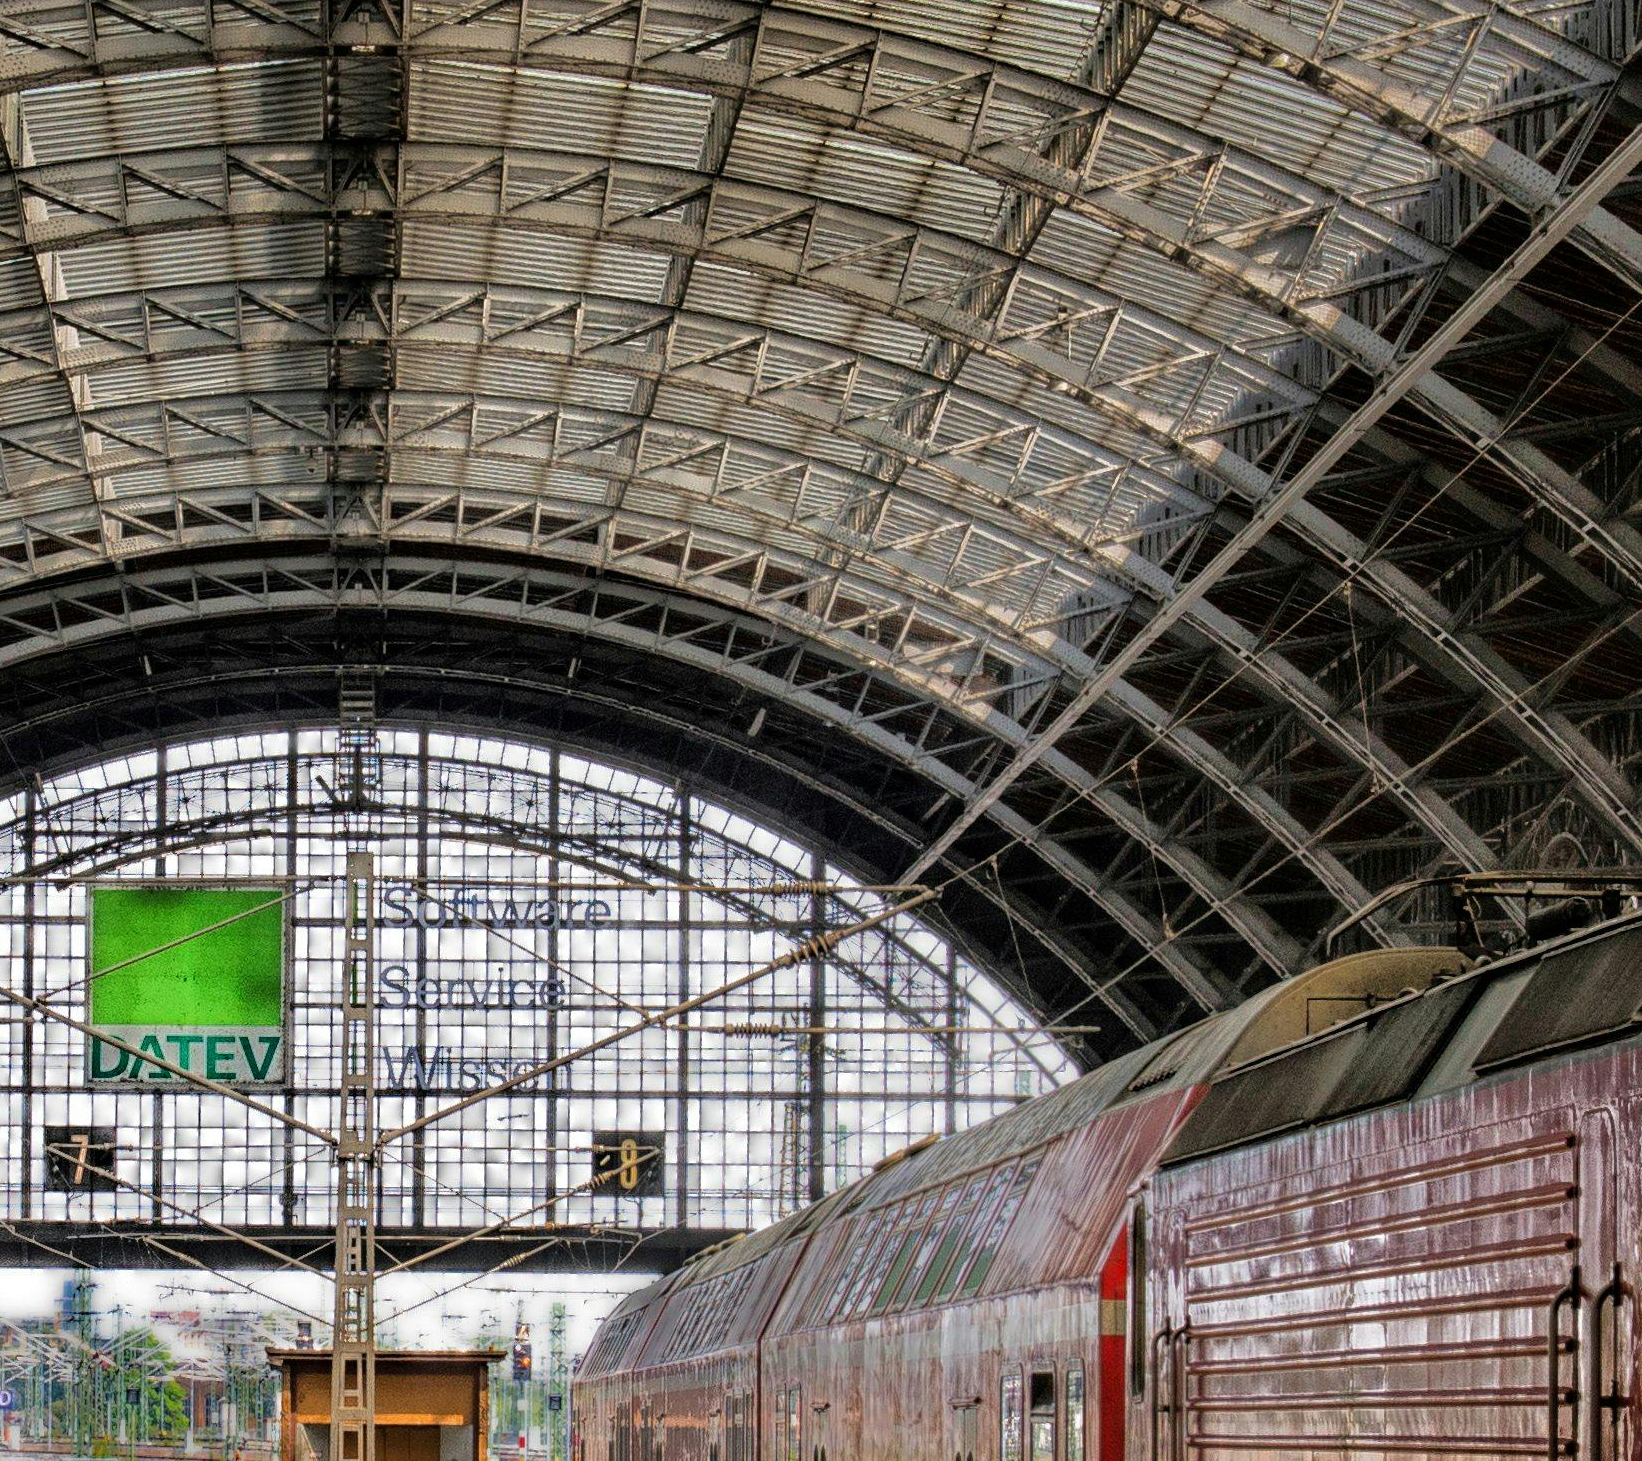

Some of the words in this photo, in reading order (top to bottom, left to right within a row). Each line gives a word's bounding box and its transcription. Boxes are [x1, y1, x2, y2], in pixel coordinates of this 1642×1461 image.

[383, 887, 611, 929] Software
[379, 965, 566, 1010] Service
[90, 1035, 281, 1081] DATEV
[71, 1134, 89, 1185] 7
[621, 1139, 638, 1190] 8
[0, 1391, 12, 1406] D
